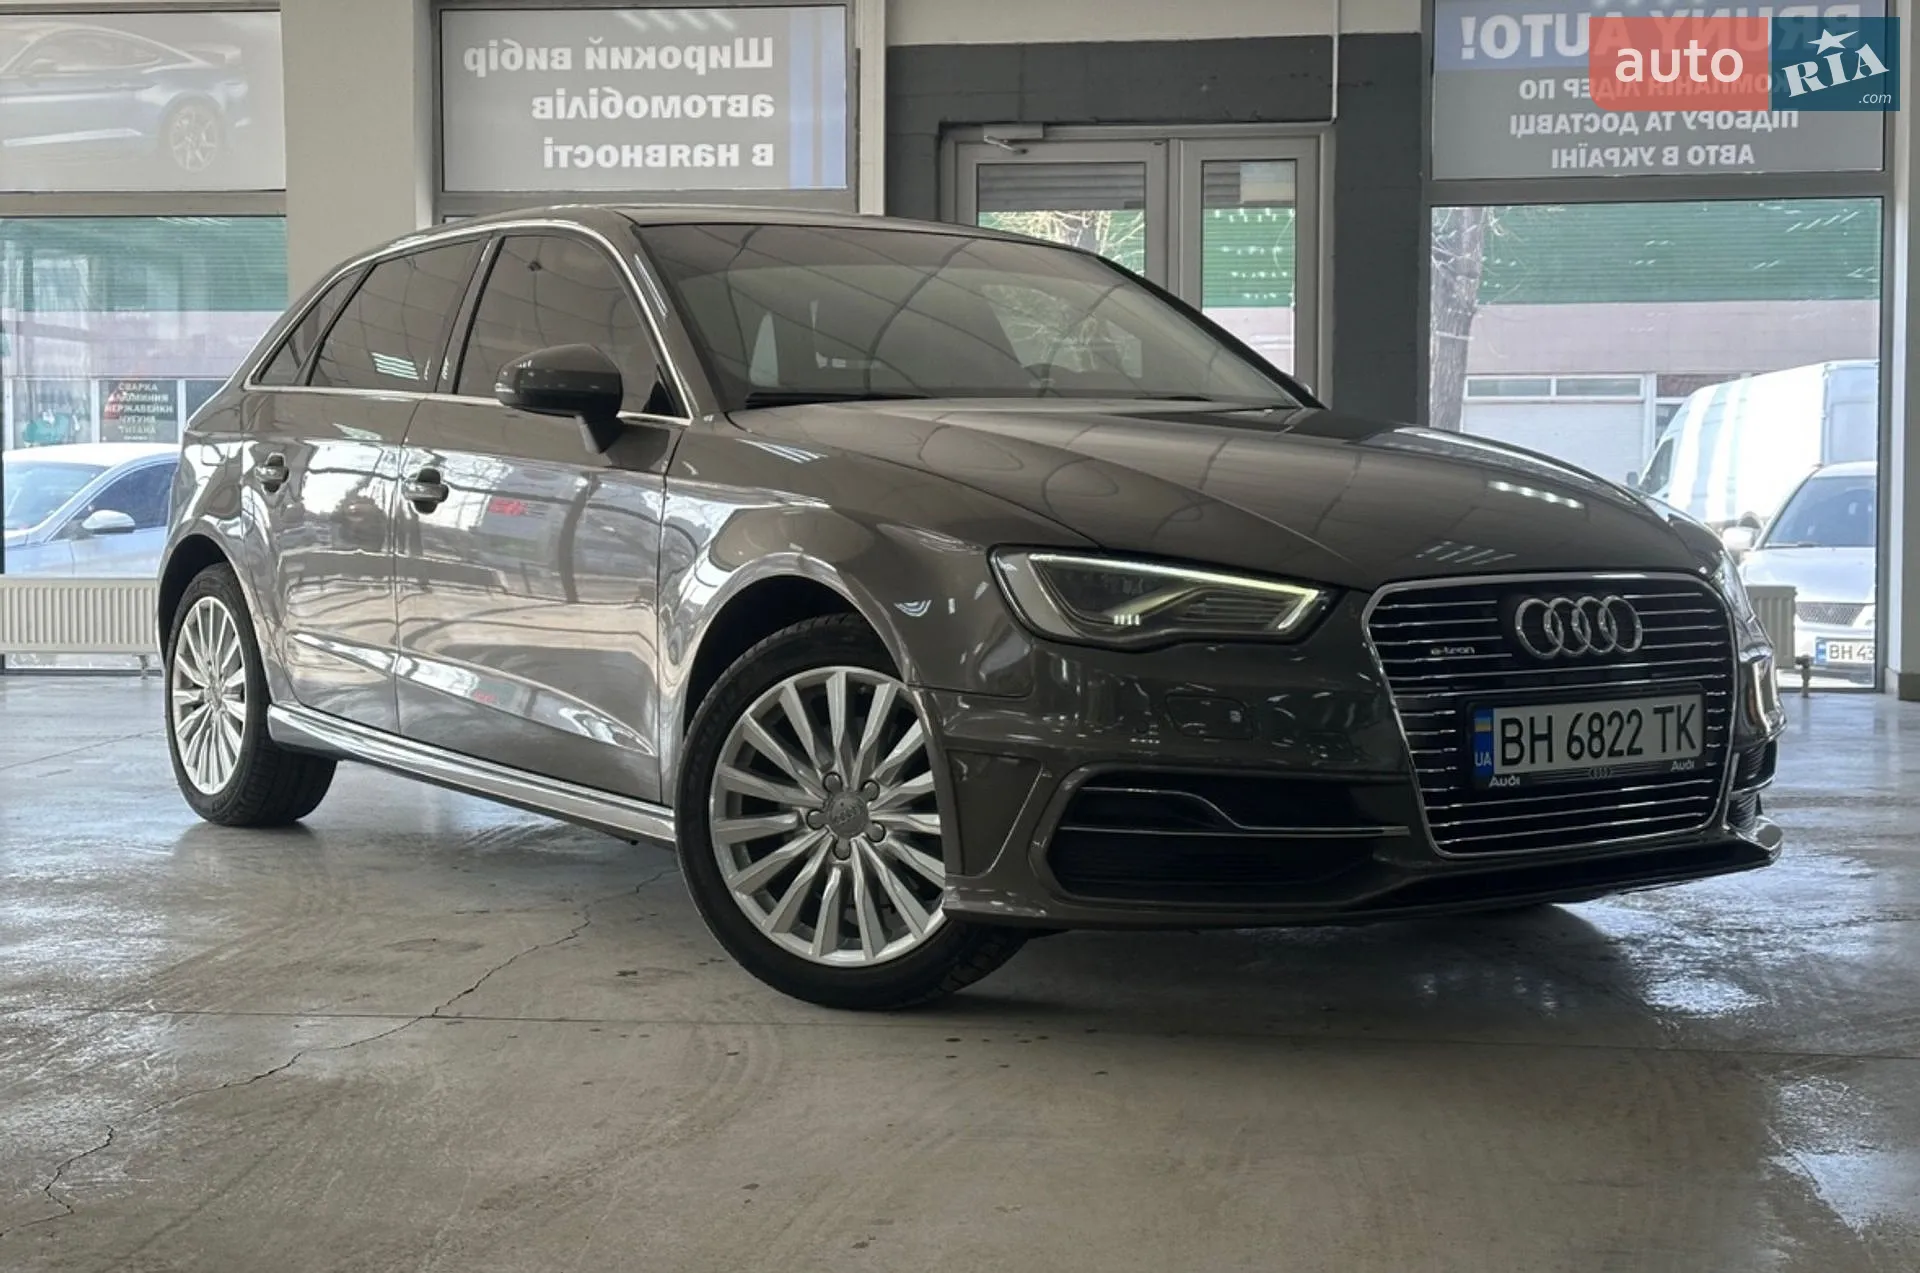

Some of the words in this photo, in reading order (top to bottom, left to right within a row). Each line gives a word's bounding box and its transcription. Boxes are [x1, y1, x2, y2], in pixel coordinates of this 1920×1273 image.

[1829, 644, 1853, 660] BH
[1500, 714, 1554, 766] BH
[1566, 708, 1644, 761] 6822
[1653, 703, 1697, 753] TK
[1474, 751, 1492, 767] UA
[1670, 760, 1695, 772] Audi
[1489, 775, 1521, 787] Audi
